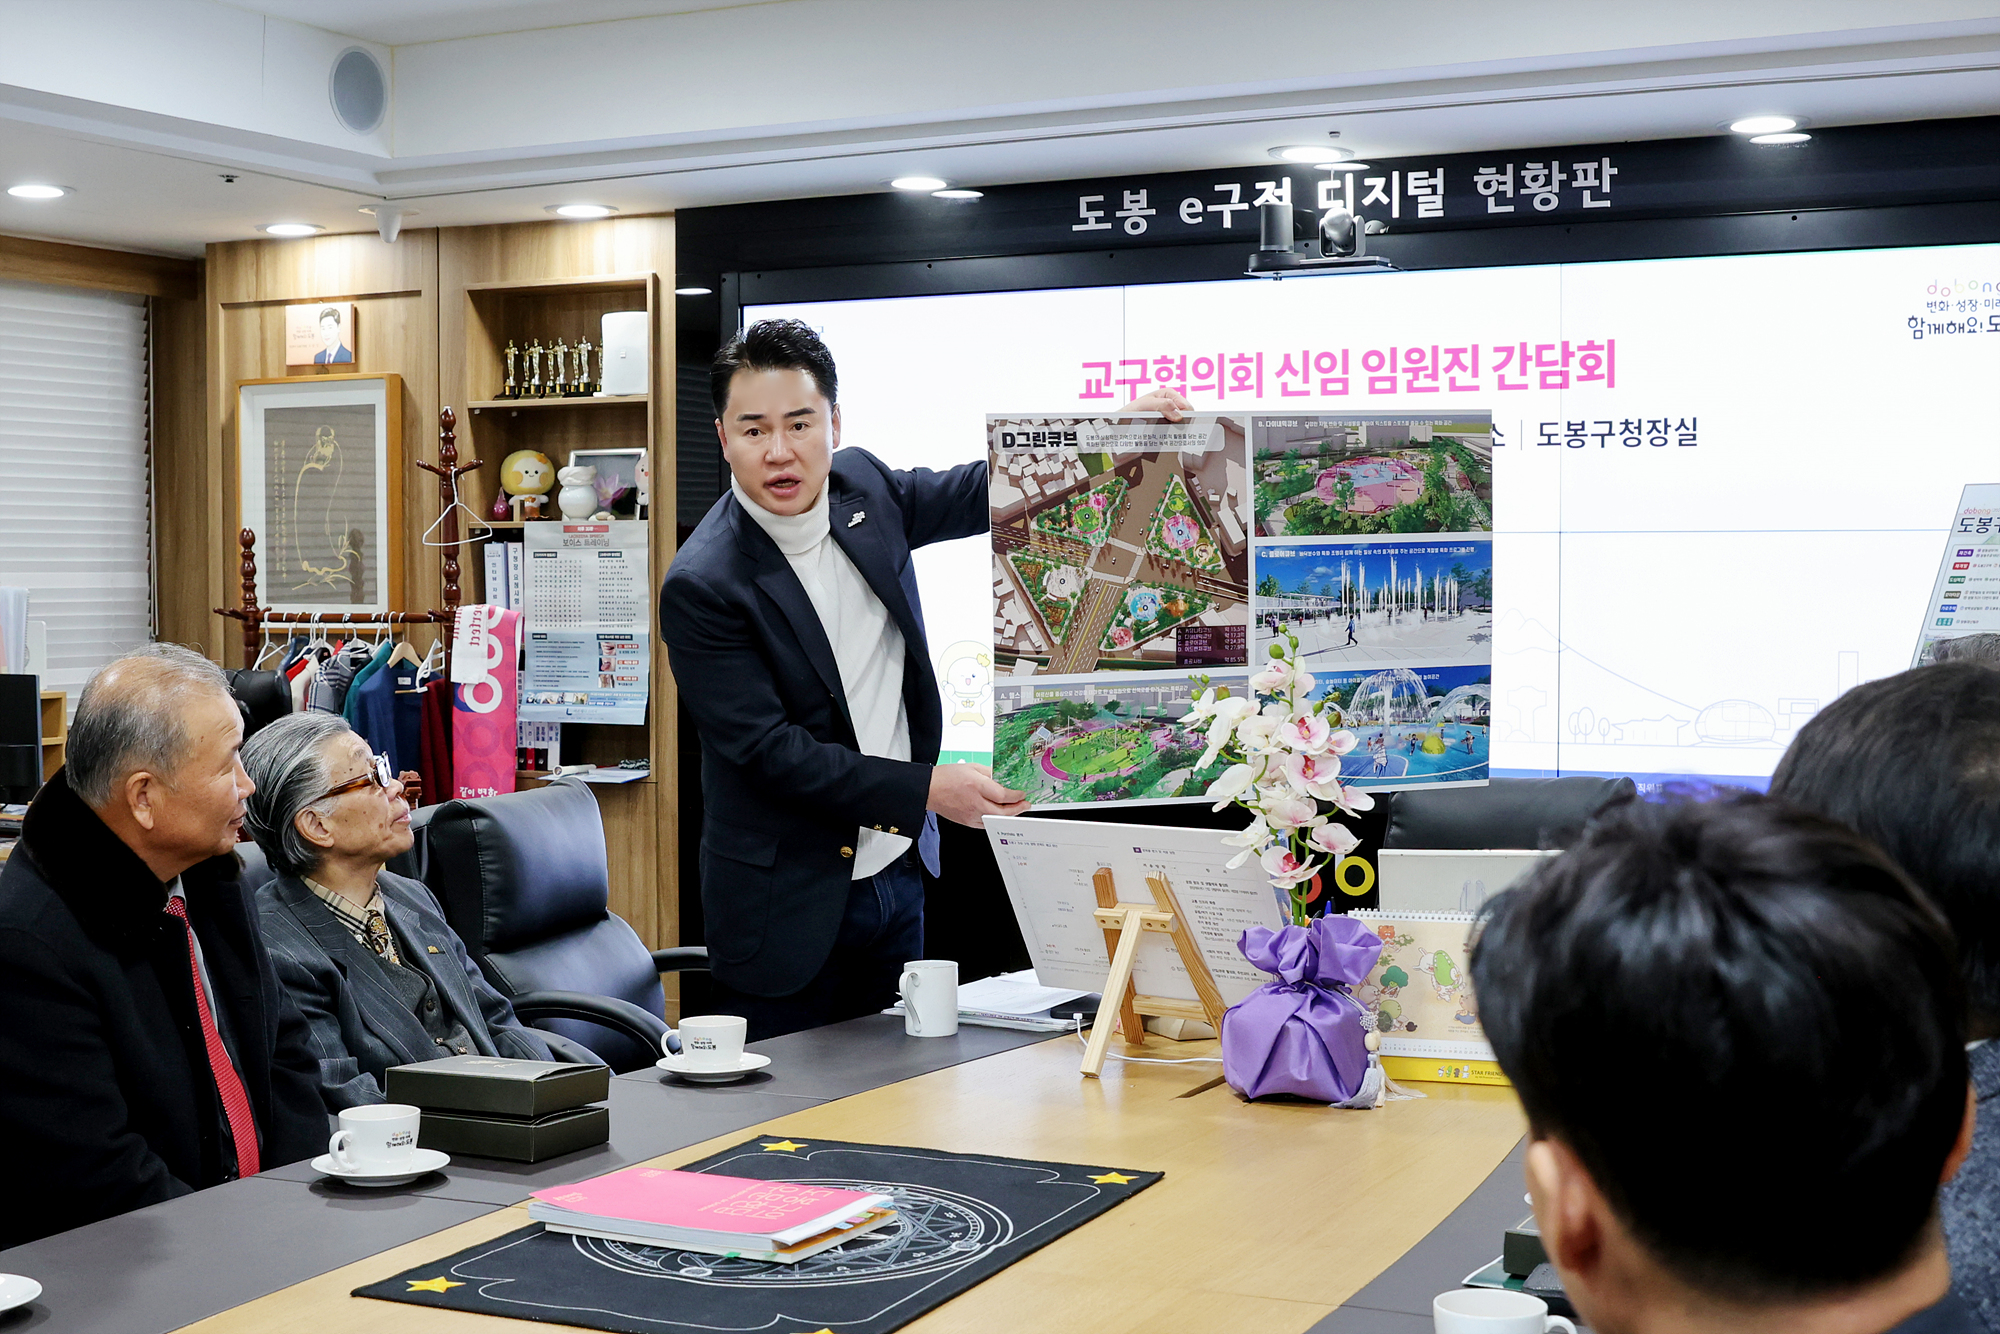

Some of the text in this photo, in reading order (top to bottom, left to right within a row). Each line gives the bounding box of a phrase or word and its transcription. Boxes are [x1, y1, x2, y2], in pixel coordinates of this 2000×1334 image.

[1072, 188, 1157, 235] 도봉
[1317, 167, 1444, 221] 디지털
[1475, 157, 1618, 214] 현황판
[1908, 315, 1983, 340] 함께해요!
[1079, 339, 1616, 401] 교구협의회 신임 임원진 간담회
[1002, 431, 1078, 448] D그린큐브
[1536, 417, 1698, 449] 도봉구청장실
[584, 538, 609, 546] 트레이닝
[459, 786, 475, 798] 같이
